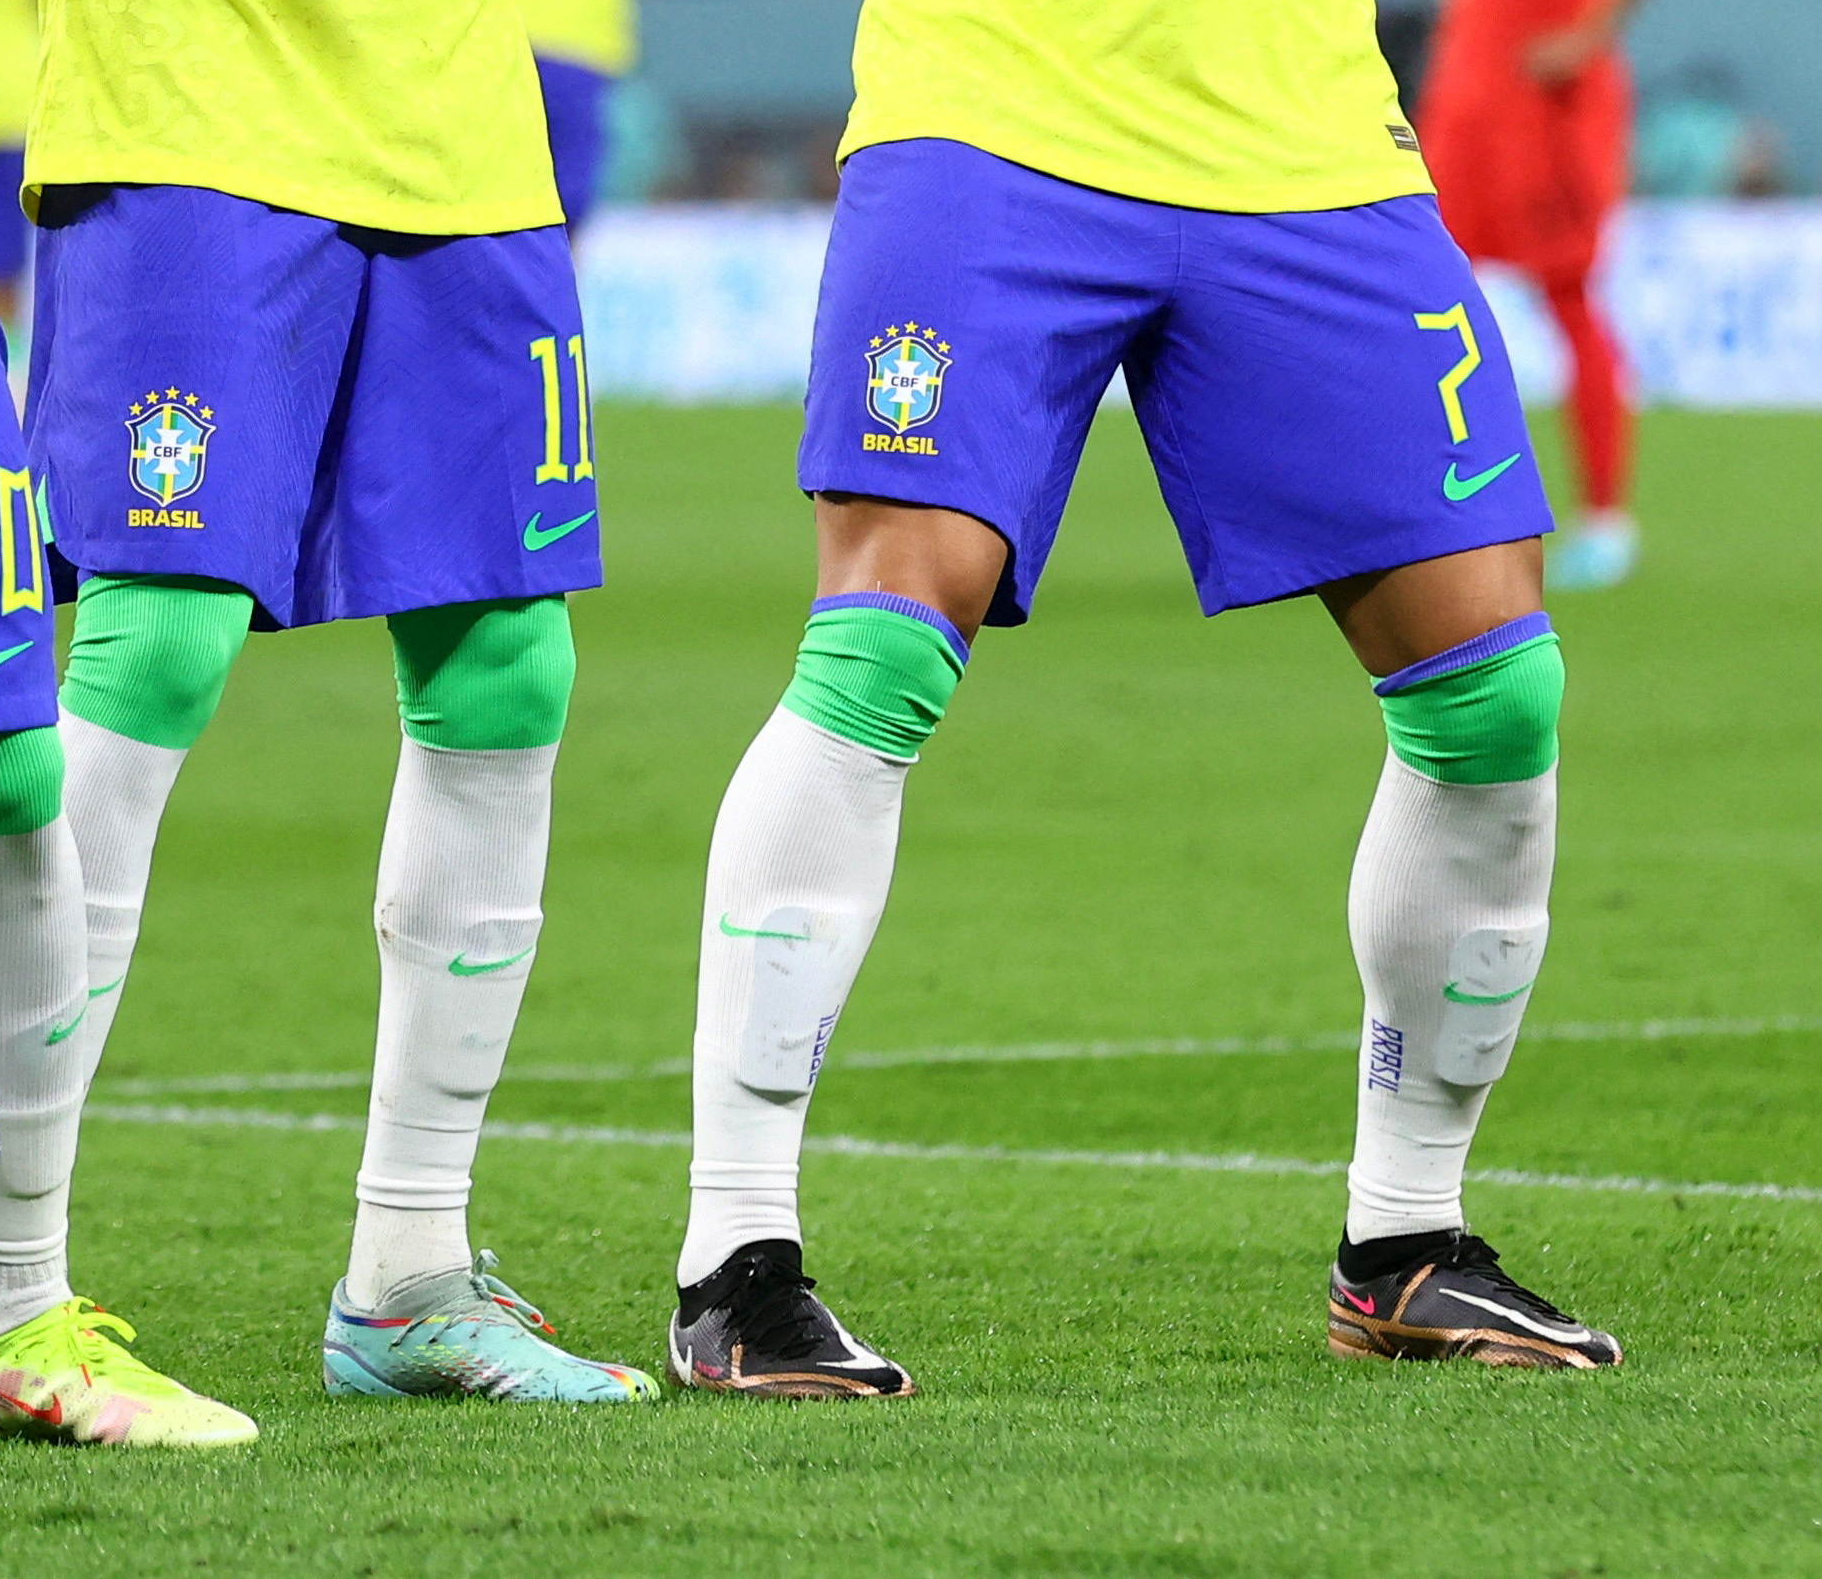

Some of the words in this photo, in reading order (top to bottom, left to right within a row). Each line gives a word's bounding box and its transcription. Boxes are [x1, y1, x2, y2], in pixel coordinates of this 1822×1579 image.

[890, 376, 919, 388] CBF
[1414, 302, 1481, 445] 7
[529, 333, 595, 486] 11
[153, 446, 183, 458] CBF
[862, 432, 940, 456] BRASIL
[127, 508, 205, 529] BRASIL
[1368, 1017, 1403, 1094] BRASIL
